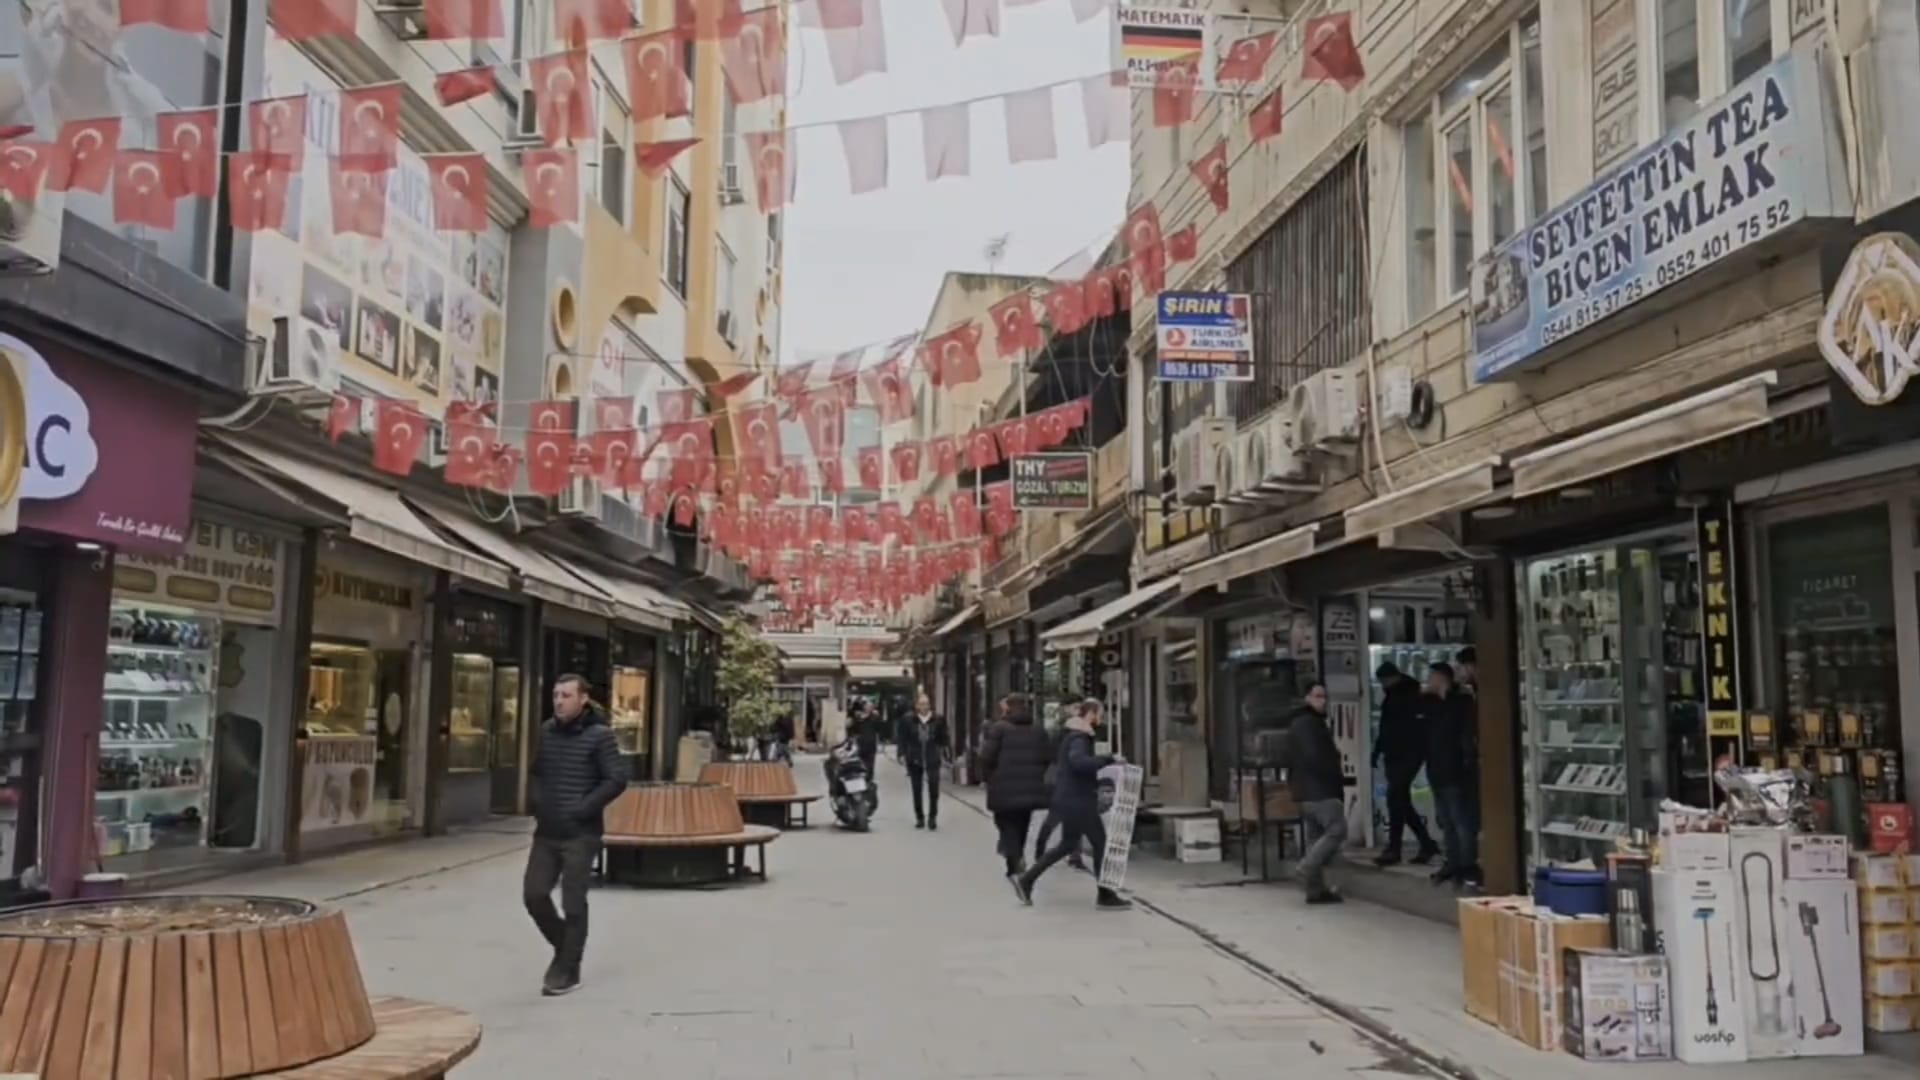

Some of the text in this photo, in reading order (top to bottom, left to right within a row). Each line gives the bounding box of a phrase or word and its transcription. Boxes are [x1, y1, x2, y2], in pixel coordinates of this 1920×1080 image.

[1707, 77, 1789, 159] TEA
[1642, 141, 1775, 255] EMLAK
[1542, 314, 1572, 344] 0544
[1577, 299, 1600, 325] 815
[1605, 289, 1621, 312] 37
[1626, 277, 1643, 302] 25
[1657, 251, 1696, 285] 0552
[1701, 232, 1731, 260] 401
[1737, 215, 1761, 245] 75
[1766, 199, 1791, 229] 52
[1190, 339, 1244, 348] AIRLINES
[1694, 1032, 1736, 1045] dyson
